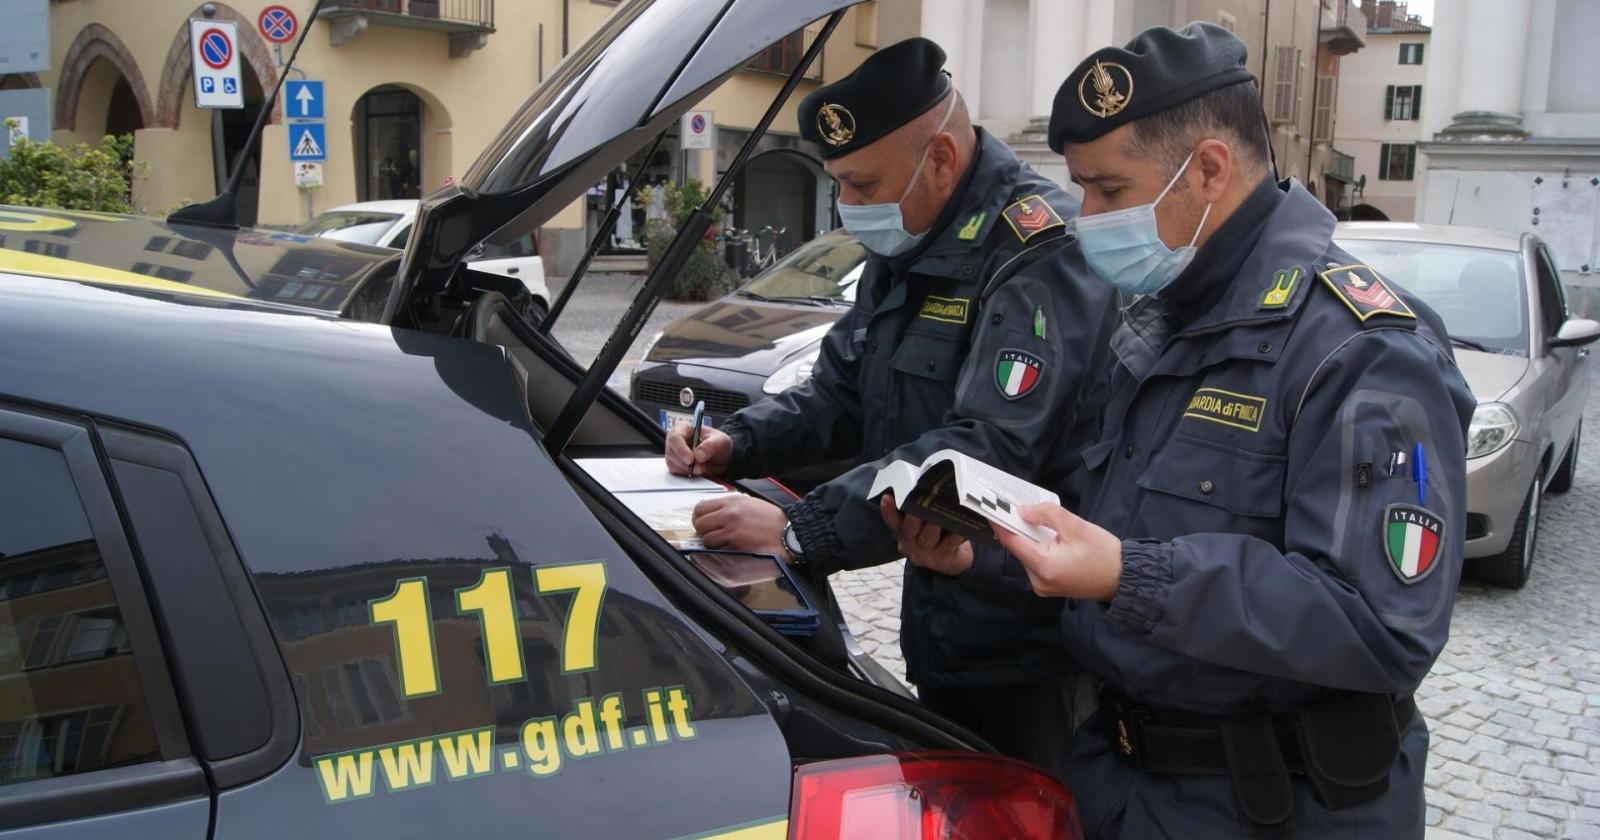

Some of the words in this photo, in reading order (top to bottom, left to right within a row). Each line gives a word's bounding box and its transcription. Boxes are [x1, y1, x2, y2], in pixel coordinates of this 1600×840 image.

[203, 78, 212, 91] P
[1005, 353, 1039, 369] ITALIA
[1189, 396, 1221, 414] UARDIA
[1222, 403, 1233, 416] di
[1394, 511, 1438, 532] ITALIA
[370, 560, 606, 698] 117
[314, 686, 697, 803] www.gdf.it
